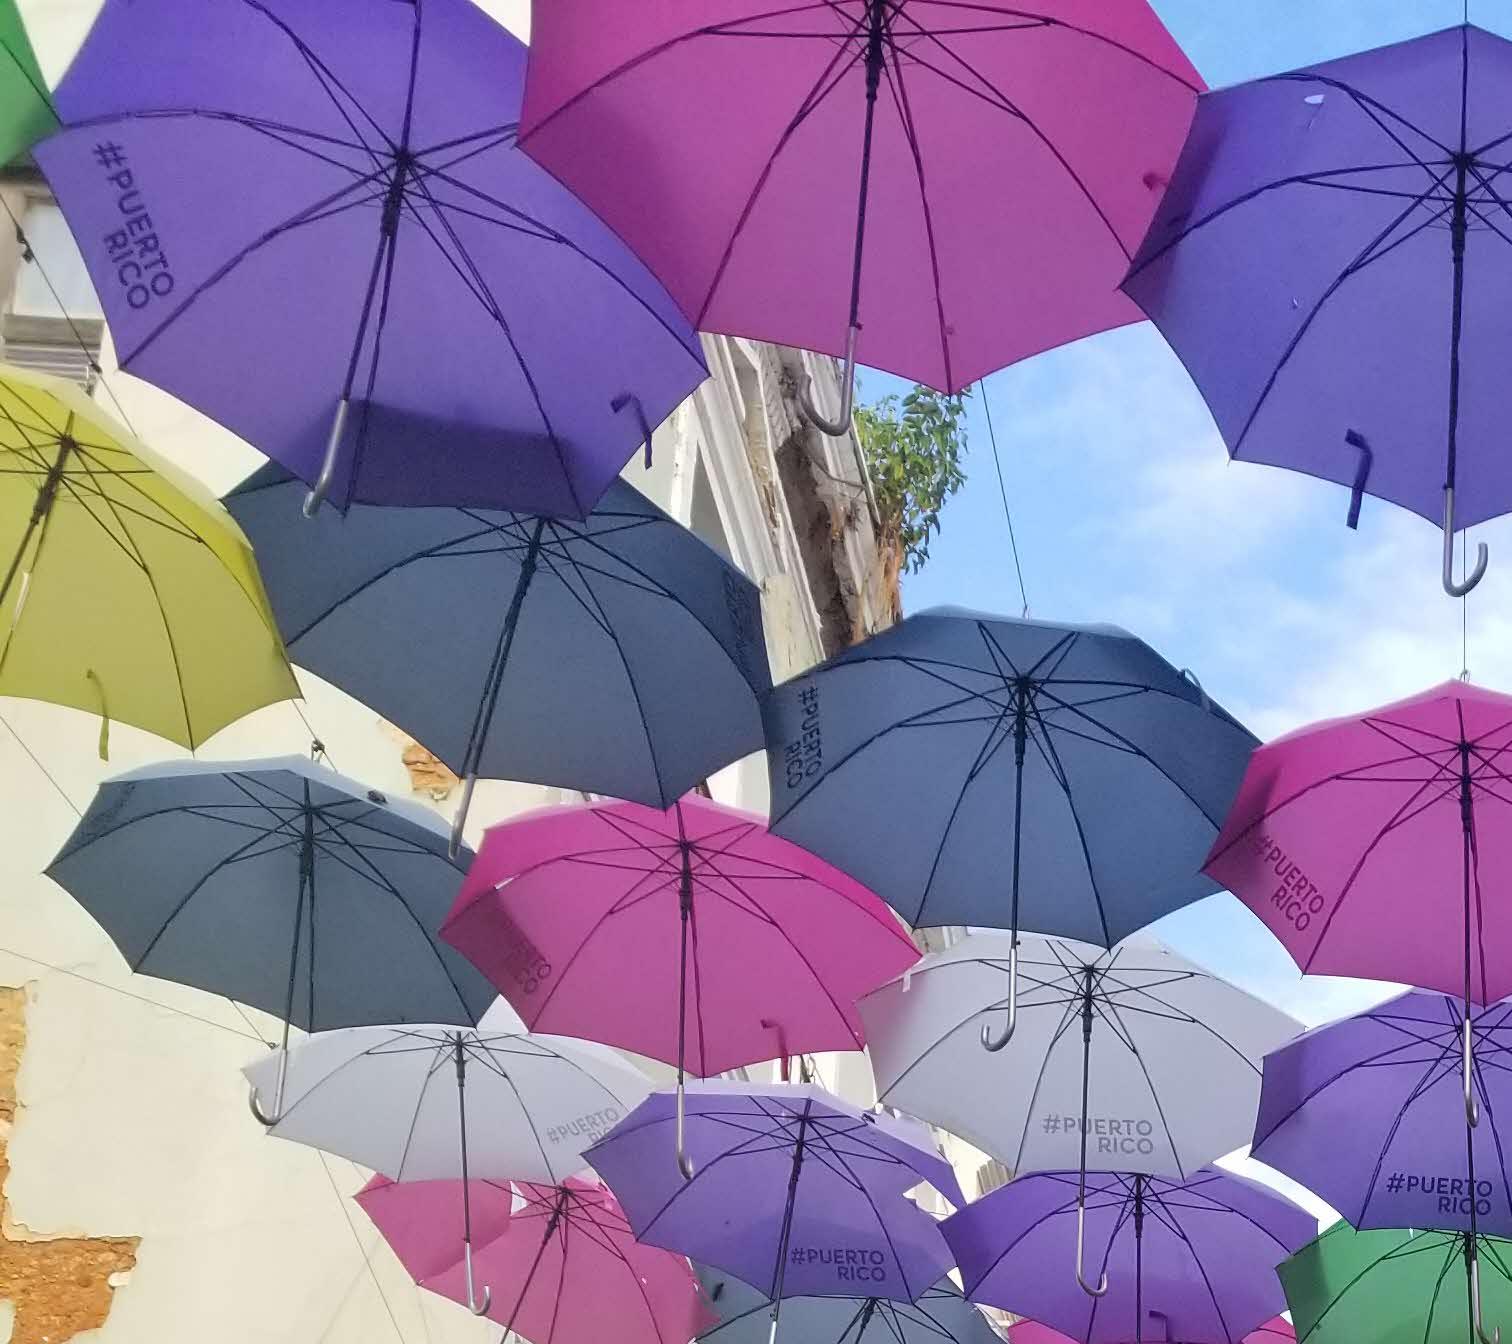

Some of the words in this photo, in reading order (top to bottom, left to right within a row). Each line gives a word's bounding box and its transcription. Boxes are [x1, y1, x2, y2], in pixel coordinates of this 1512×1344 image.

[93, 141, 174, 297] #PUERTO
[103, 232, 149, 310] RICO
[799, 686, 822, 778] #PUERTO
[784, 742, 803, 789] RICO
[1261, 836, 1324, 914] #PUERTO
[1270, 888, 1310, 932] RICO
[547, 1108, 621, 1144] #PUERTO
[1043, 1116, 1153, 1136] #PUERTO
[1097, 1138, 1153, 1156] RICO
[1386, 1172, 1493, 1196] #PUERTO
[1438, 1198, 1491, 1217] RICO
[791, 1247, 884, 1266] #PUERTO
[837, 1265, 886, 1281] RICO
